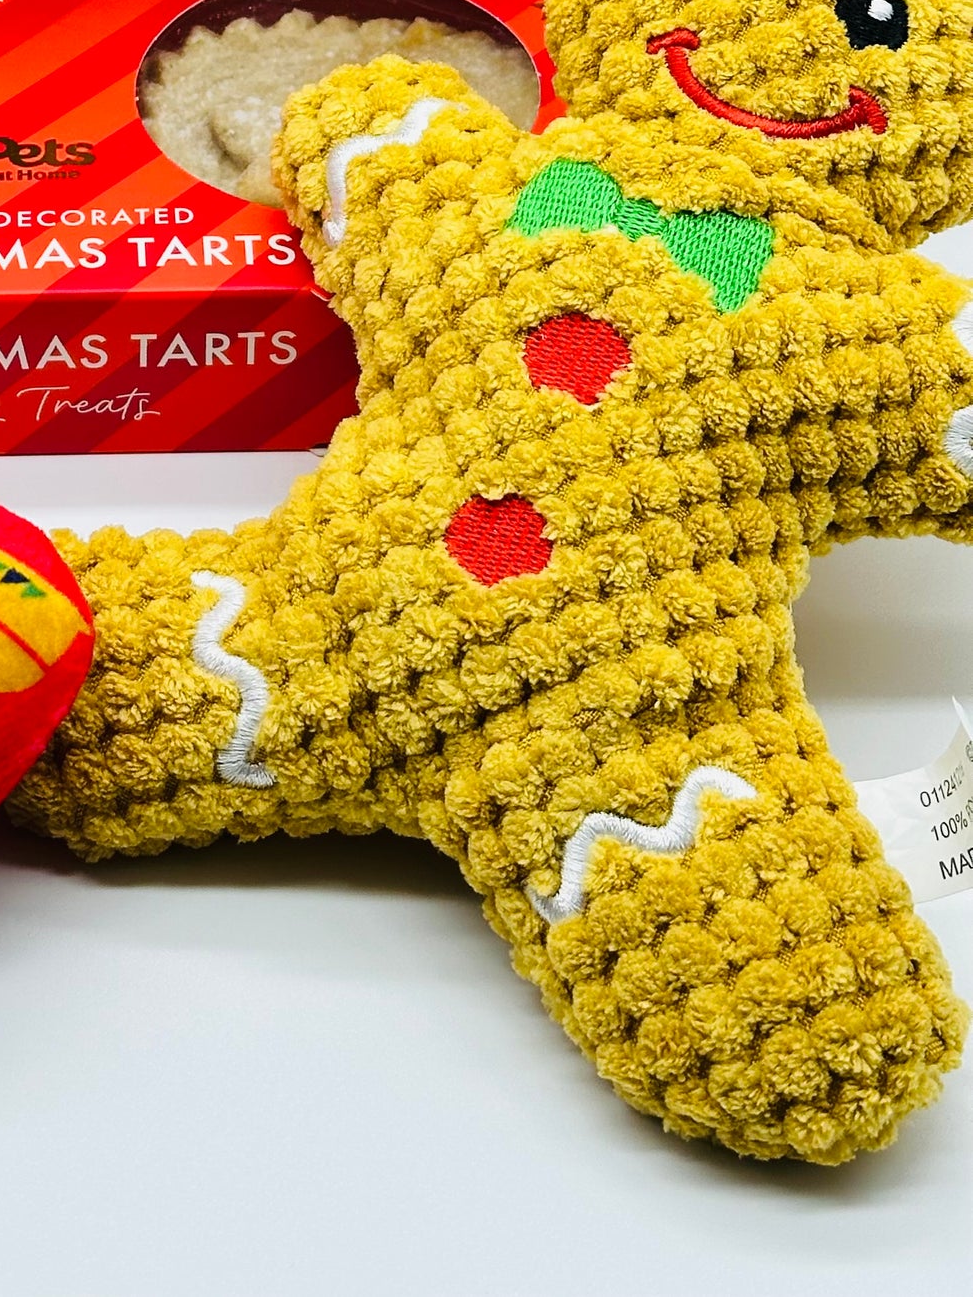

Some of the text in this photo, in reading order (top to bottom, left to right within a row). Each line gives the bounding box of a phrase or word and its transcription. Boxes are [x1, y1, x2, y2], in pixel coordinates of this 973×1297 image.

[17, 170, 81, 181] Home
[130, 234, 296, 266] TARTS
[130, 331, 298, 366] TARTS
[16, 386, 160, 422] Treats
[931, 811, 968, 841] 100%
